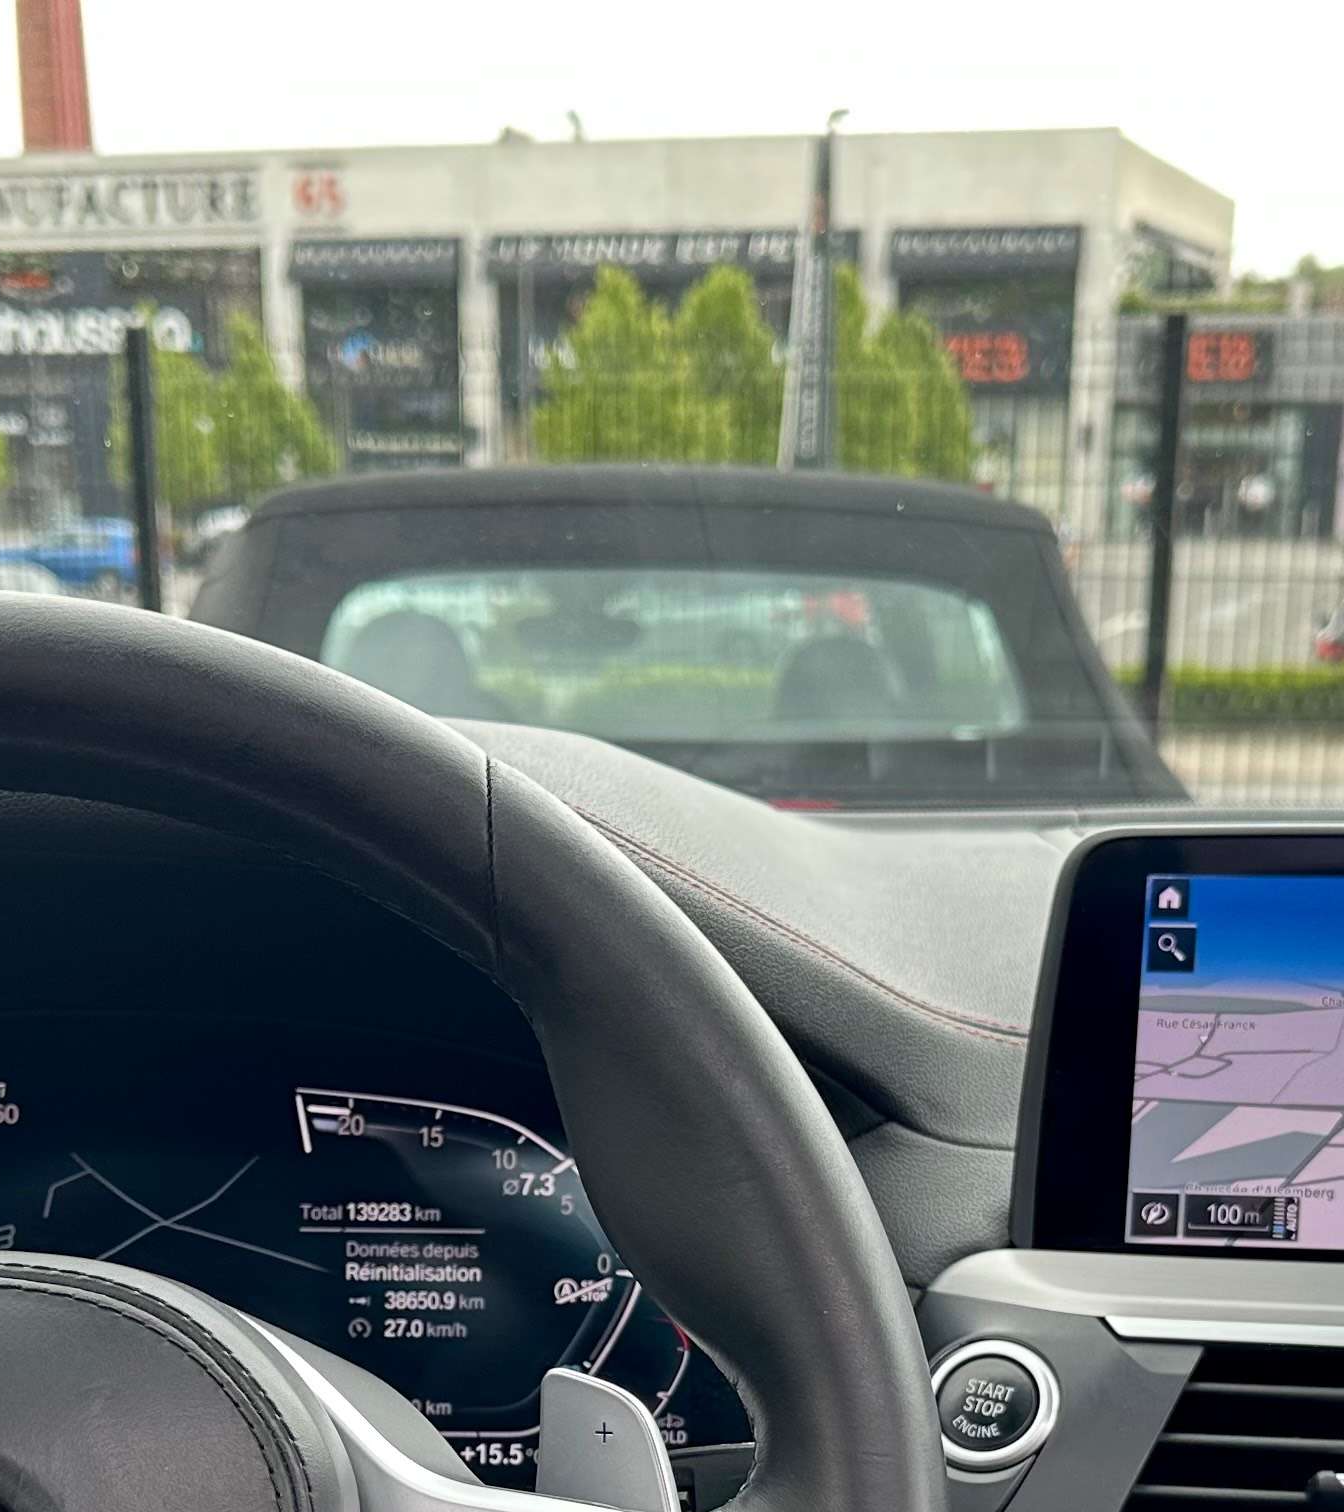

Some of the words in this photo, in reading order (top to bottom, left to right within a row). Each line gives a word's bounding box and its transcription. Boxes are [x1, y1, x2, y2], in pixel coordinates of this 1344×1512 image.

[1156, 1018, 1178, 1029] Rue
[338, 1115, 365, 1136] 20
[418, 1127, 444, 1148] 15
[492, 1150, 517, 1170] 10
[300, 1204, 342, 1221] Total
[346, 1203, 411, 1221] 139283
[415, 1204, 441, 1221] km
[560, 1197, 573, 1216] 5
[1207, 1204, 1241, 1225] 100
[1244, 1211, 1260, 1225] m
[1285, 1204, 1299, 1232] AUTO
[346, 1240, 419, 1259] Données
[423, 1242, 480, 1261] depuis
[345, 1262, 482, 1282] Réinitialisation
[597, 1254, 611, 1273] 0
[384, 1290, 455, 1310] 38650.9
[458, 1292, 485, 1310] km
[384, 1319, 424, 1338] 27.0
[426, 1320, 467, 1339] km/h
[965, 1378, 1014, 1401] START
[425, 1399, 452, 1416] km
[963, 1396, 1005, 1417] STOP
[952, 1414, 1001, 1438] ENGINE
